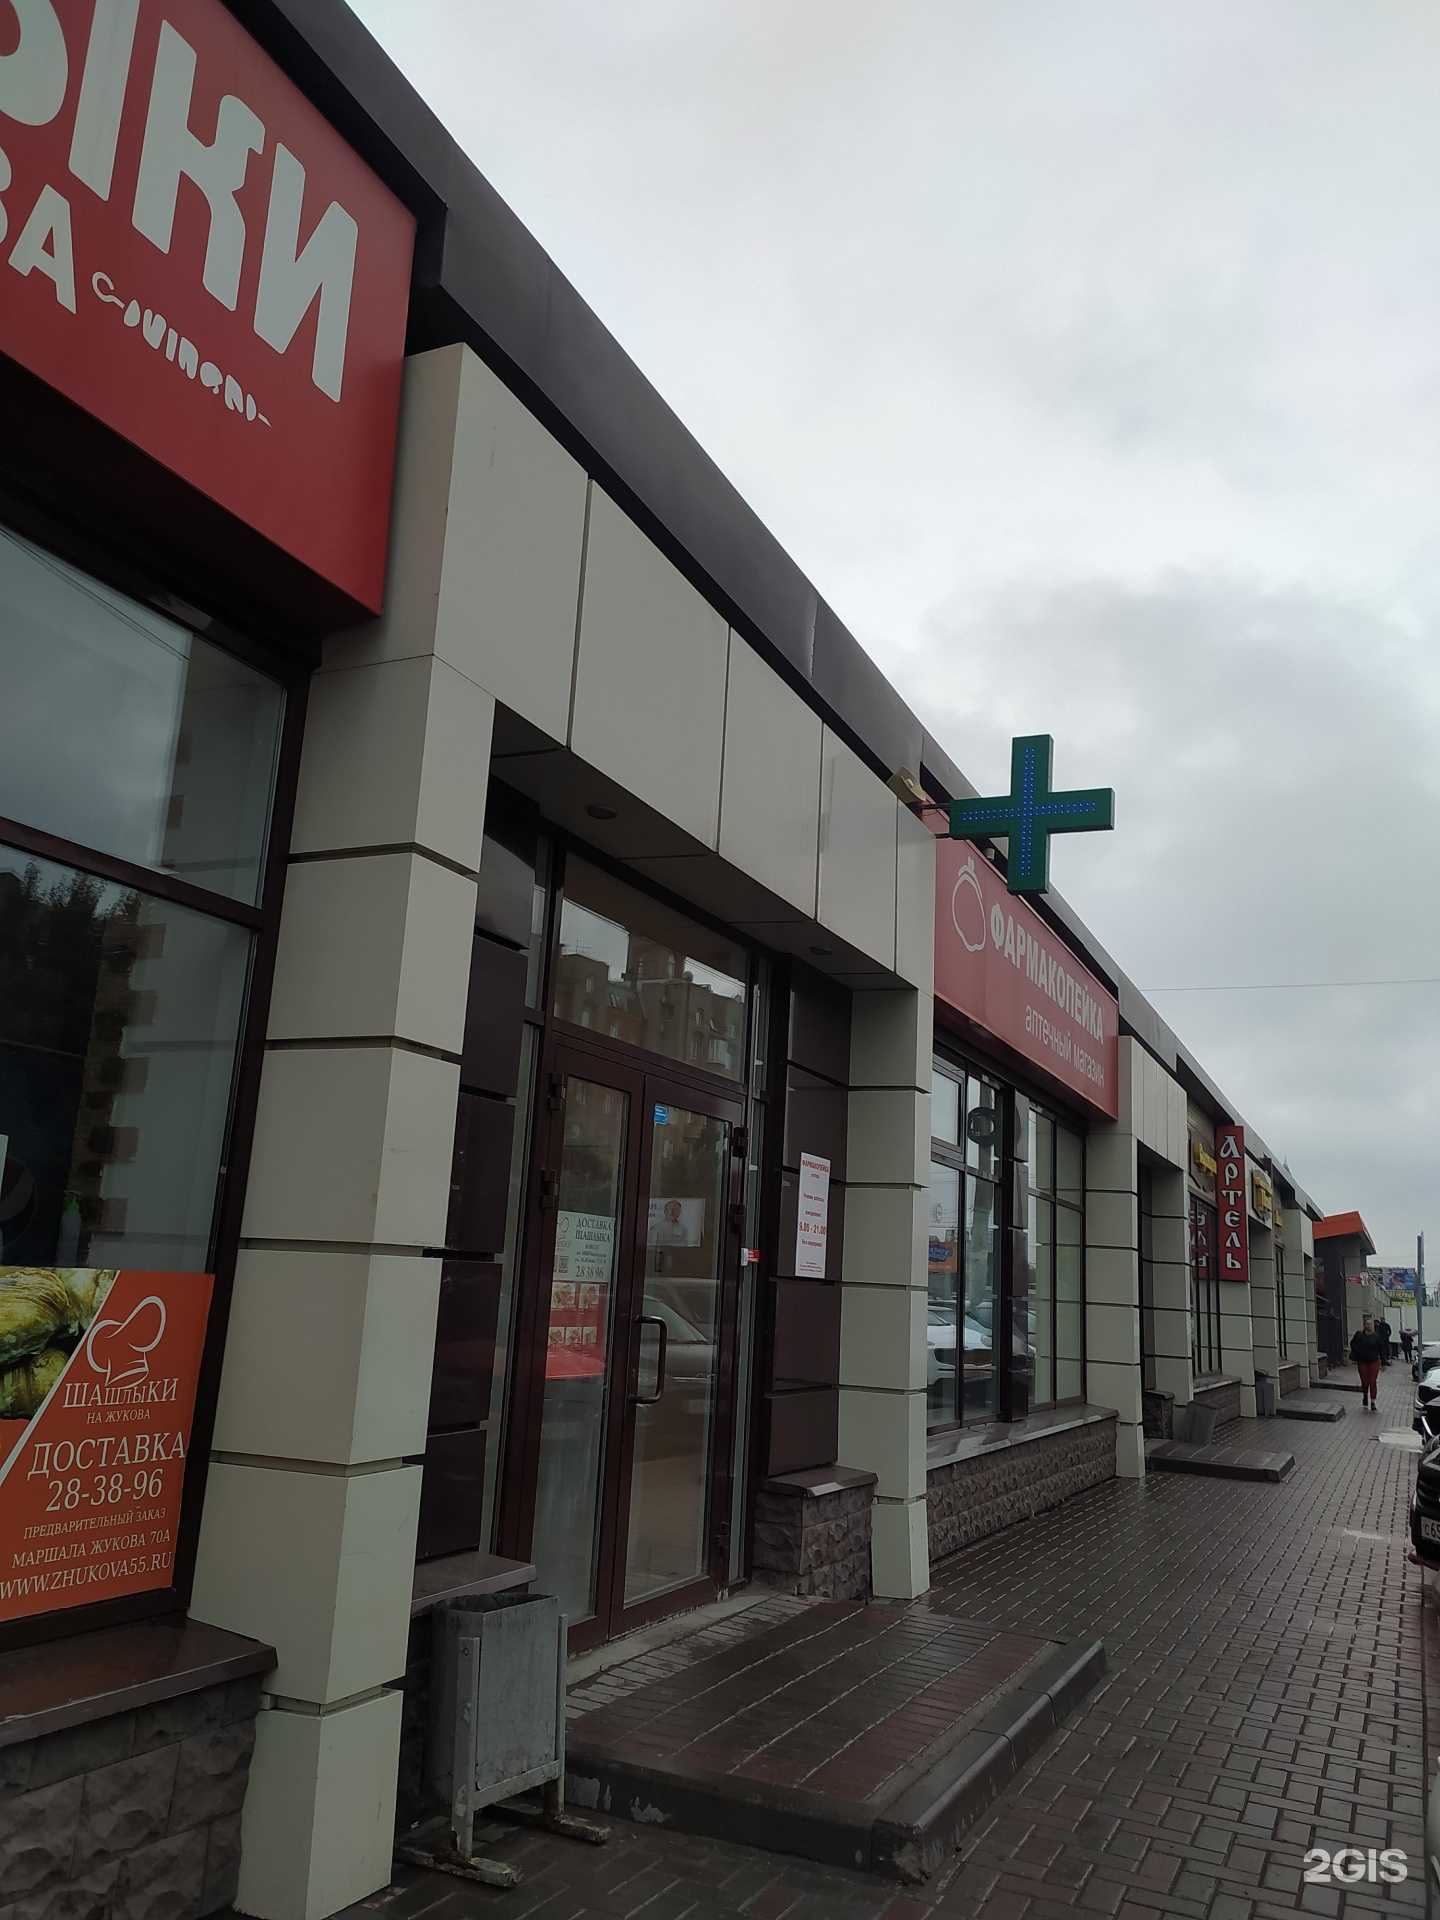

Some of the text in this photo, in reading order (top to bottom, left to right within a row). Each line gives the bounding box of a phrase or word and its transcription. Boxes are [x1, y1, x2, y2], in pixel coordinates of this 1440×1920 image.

[990, 903, 1104, 1045] ФАРМАКОПЕЙКА
[1024, 1004, 1104, 1088] аптечный магазин
[1220, 1135, 1242, 1269] АРТЕЛЬ
[87, 1409, 151, 1424] НА ЖУКОВА
[27, 1431, 186, 1480] ДОСТАВКА
[46, 1468, 164, 1511] 28-38-96
[24, 1507, 166, 1539] ПРЕДВАРИТЕЛЬНЫЙ ЗАКАЗ
[12, 1543, 86, 1568] МАРШАЛА
[90, 1533, 146, 1555] ЖУКОВА
[0, 1552, 172, 1599] WWW.ZHUKOVA55.RU
